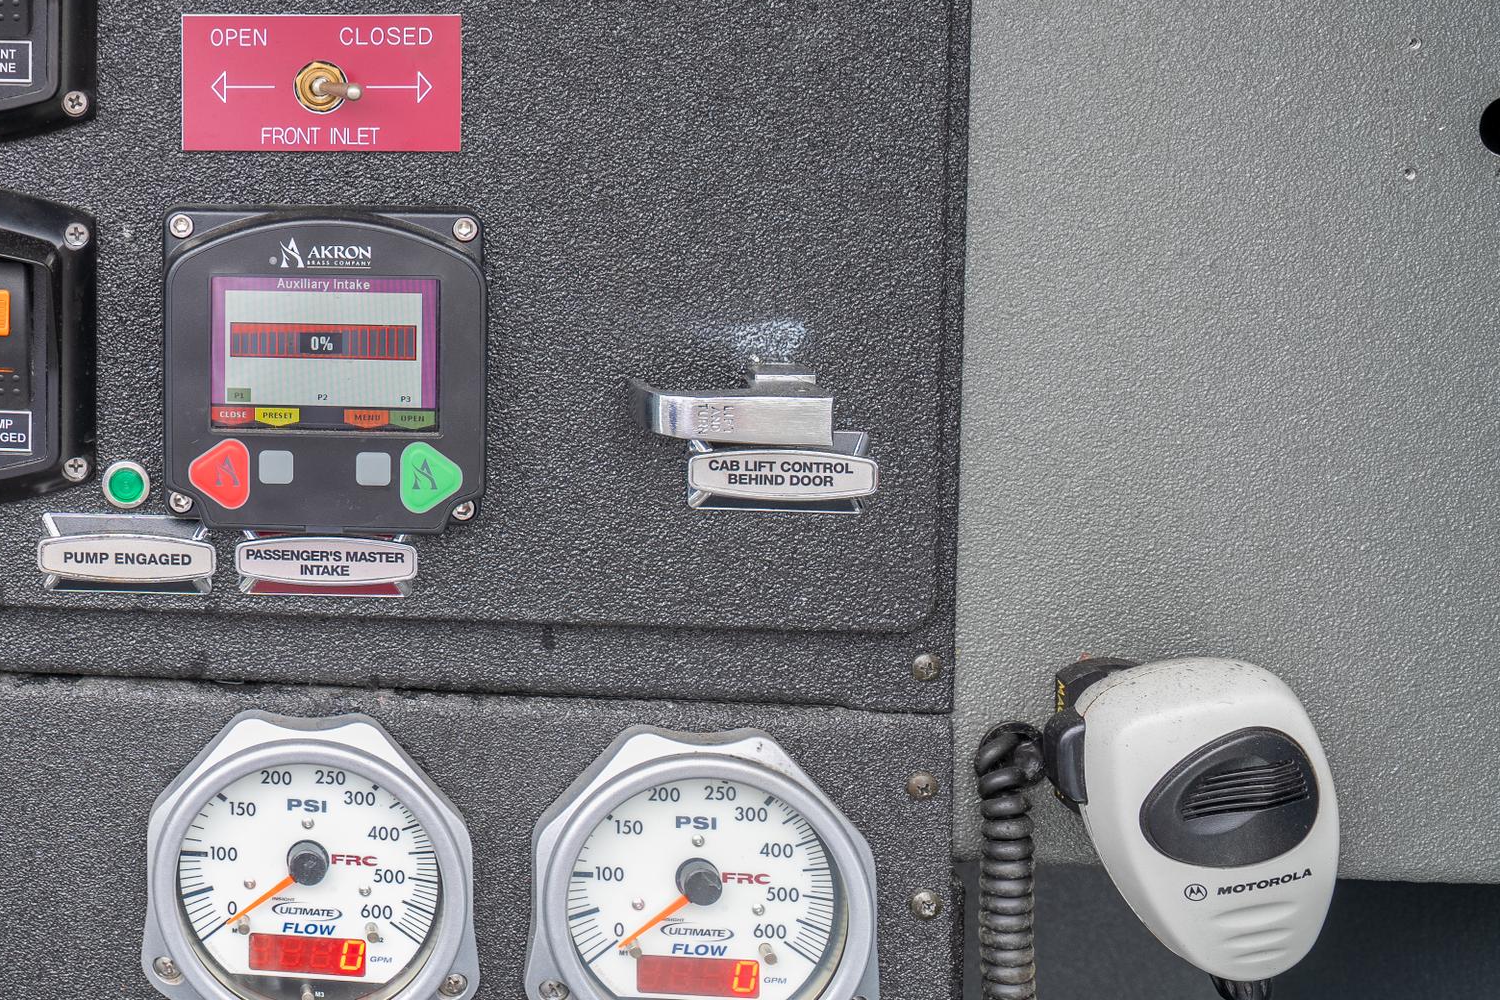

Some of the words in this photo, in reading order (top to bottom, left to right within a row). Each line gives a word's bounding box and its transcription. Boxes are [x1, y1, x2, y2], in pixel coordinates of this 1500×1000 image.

[210, 28, 268, 46] OPEN
[340, 27, 432, 46] CLOSED
[261, 128, 320, 145] FRONT
[330, 128, 380, 144] INLET
[307, 246, 371, 259] AKRON
[277, 278, 330, 291] Auxiliary
[334, 280, 370, 290] Intake
[311, 336, 333, 351] 0%
[709, 460, 740, 471] CAB
[745, 461, 776, 472] LIFT
[780, 462, 853, 474] CONTROL
[728, 474, 785, 485] BEHIND
[790, 475, 833, 486] DOOR
[63, 553, 109, 565] PUMP
[114, 552, 192, 566] ENGAGED
[246, 550, 342, 563] PASSENGER'S
[346, 551, 404, 564] MASTER
[300, 565, 350, 576] INTAKE
[287, 799, 327, 813] PSI
[331, 854, 378, 866] FRC
[1217, 868, 1312, 895] MOTOROLA
[279, 906, 335, 918] ULTIMATE
[361, 905, 393, 919] 600
[282, 922, 336, 936] FLOW
[370, 956, 392, 964] GPM
